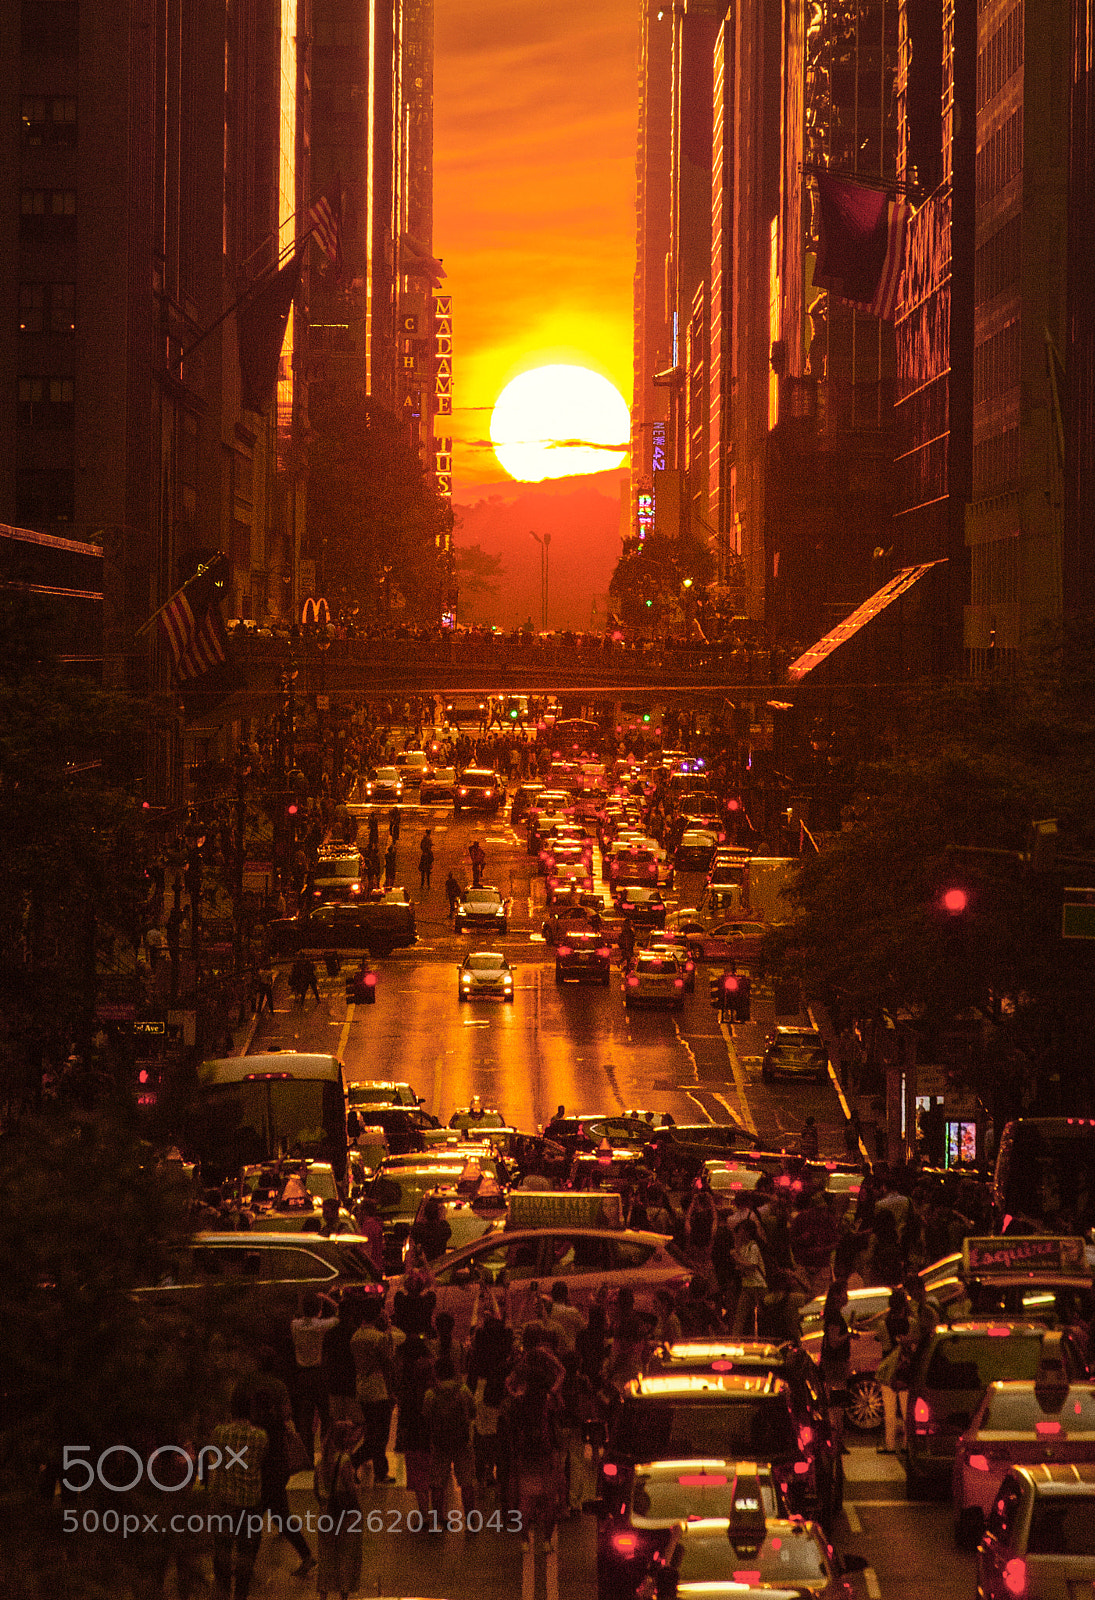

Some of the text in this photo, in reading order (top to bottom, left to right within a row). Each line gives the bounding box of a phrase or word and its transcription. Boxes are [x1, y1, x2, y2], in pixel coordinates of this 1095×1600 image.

[435, 298, 452, 414] MADAME
[652, 422, 666, 471] NEW 42
[302, 597, 331, 624] M
[144, 1024, 159, 1032] Ave
